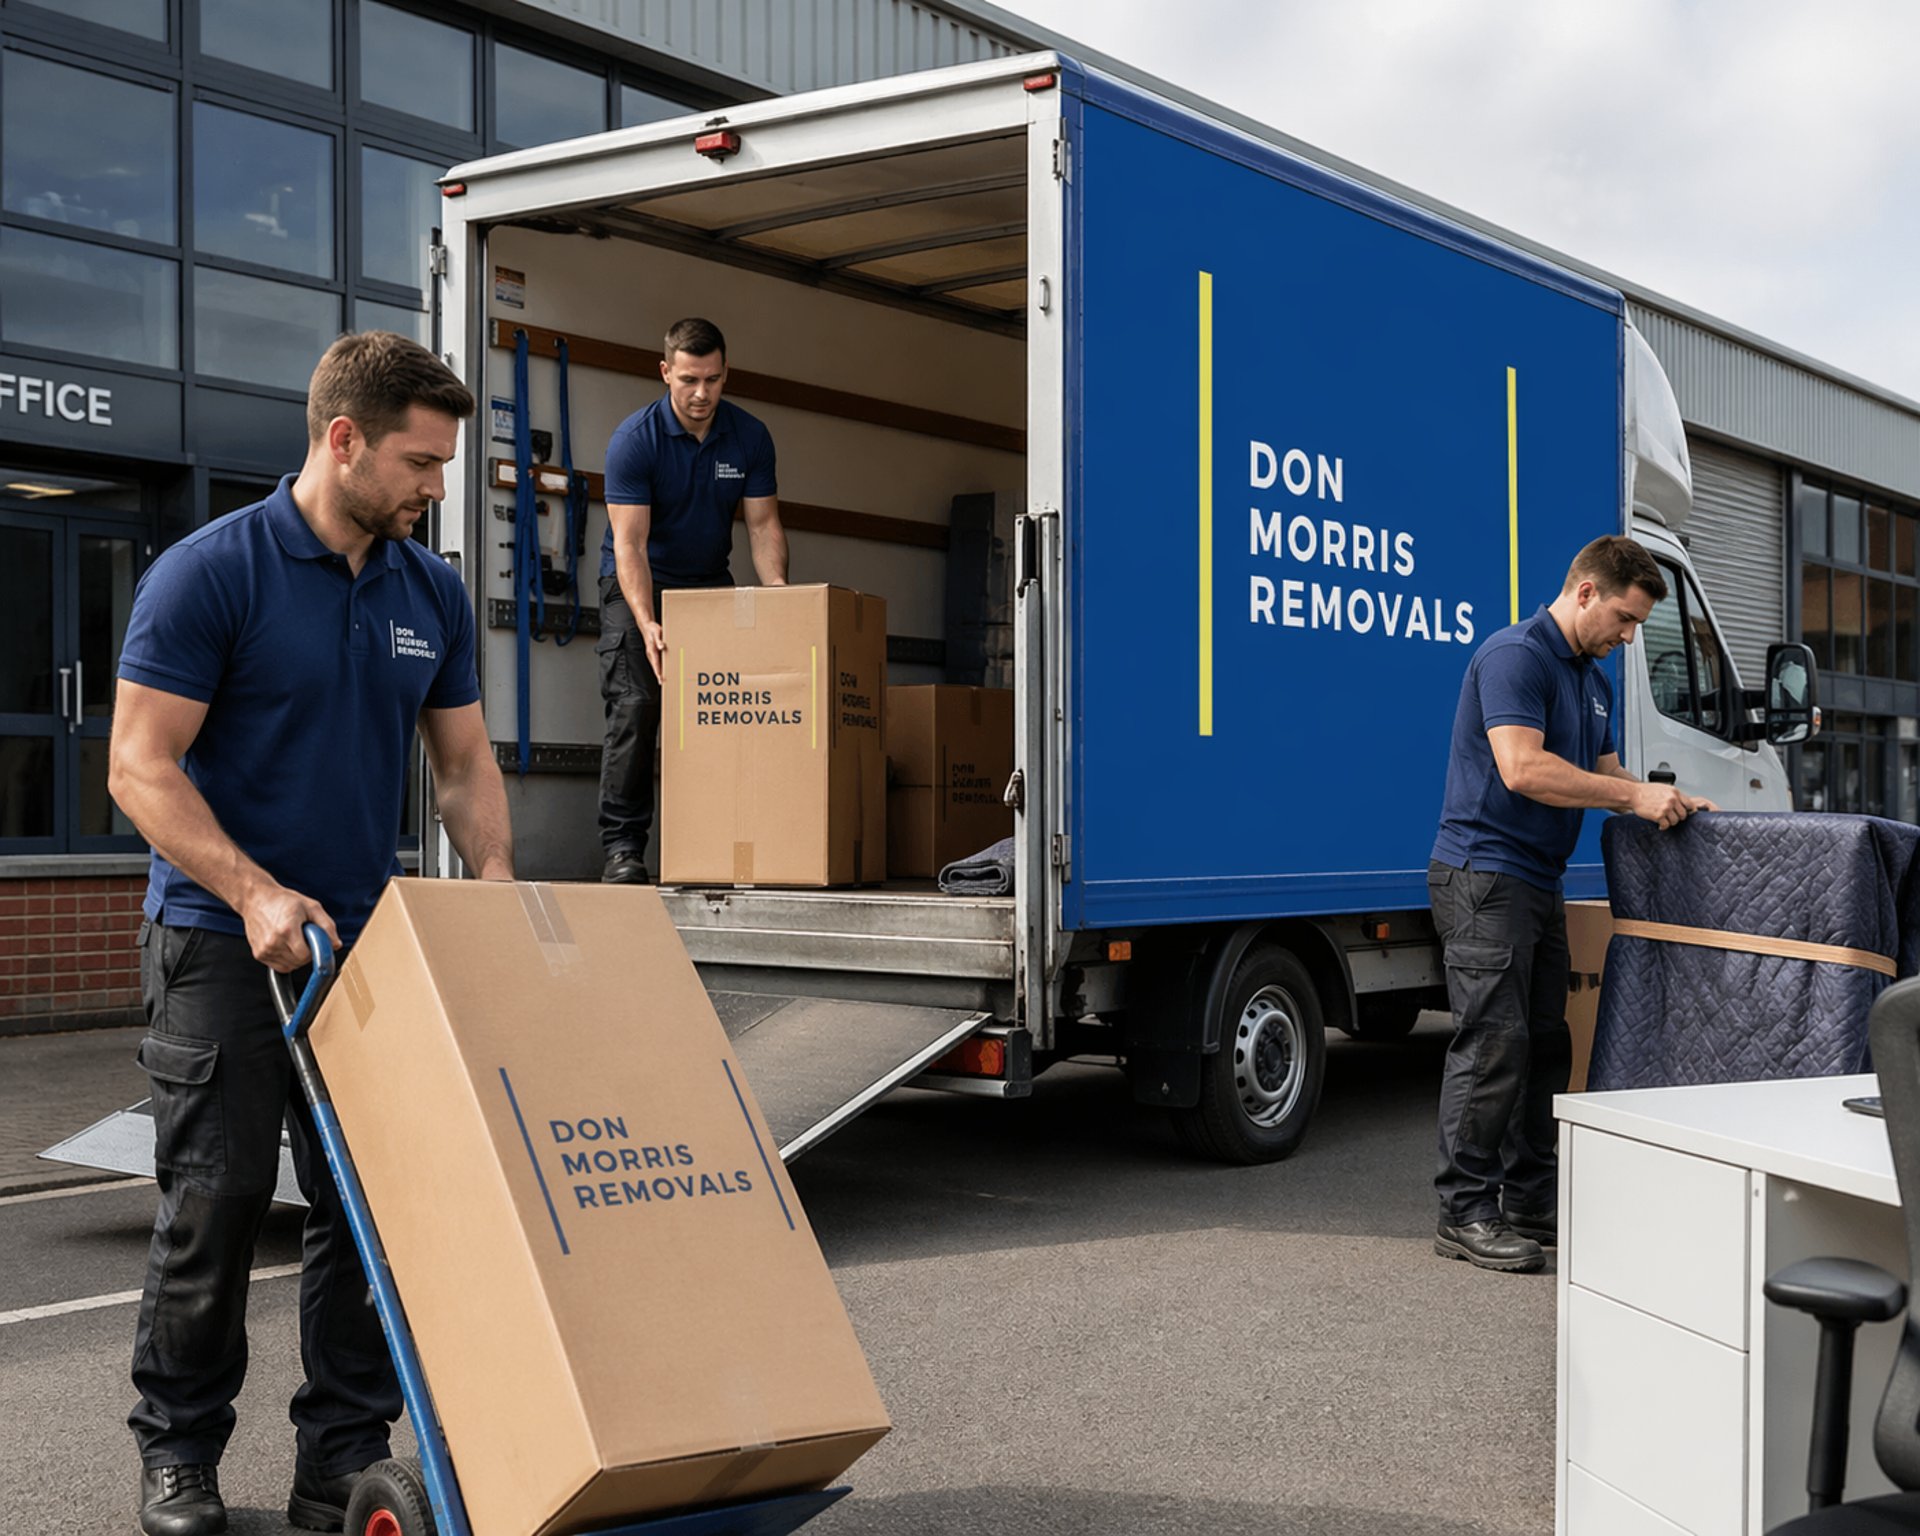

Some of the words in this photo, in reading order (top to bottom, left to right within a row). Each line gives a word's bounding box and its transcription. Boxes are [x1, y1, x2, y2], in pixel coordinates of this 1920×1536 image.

[1250, 440, 1343, 503] DON
[1250, 507, 1415, 577] MORRIS
[1250, 575, 1475, 645] REMOVALS
[697, 672, 740, 686] DON
[697, 691, 772, 706] MORRIS
[697, 710, 802, 725] REMOVALS
[549, 1116, 629, 1144] DON
[560, 1144, 694, 1176] MORRIS
[573, 1170, 753, 1209] REMOVALS
